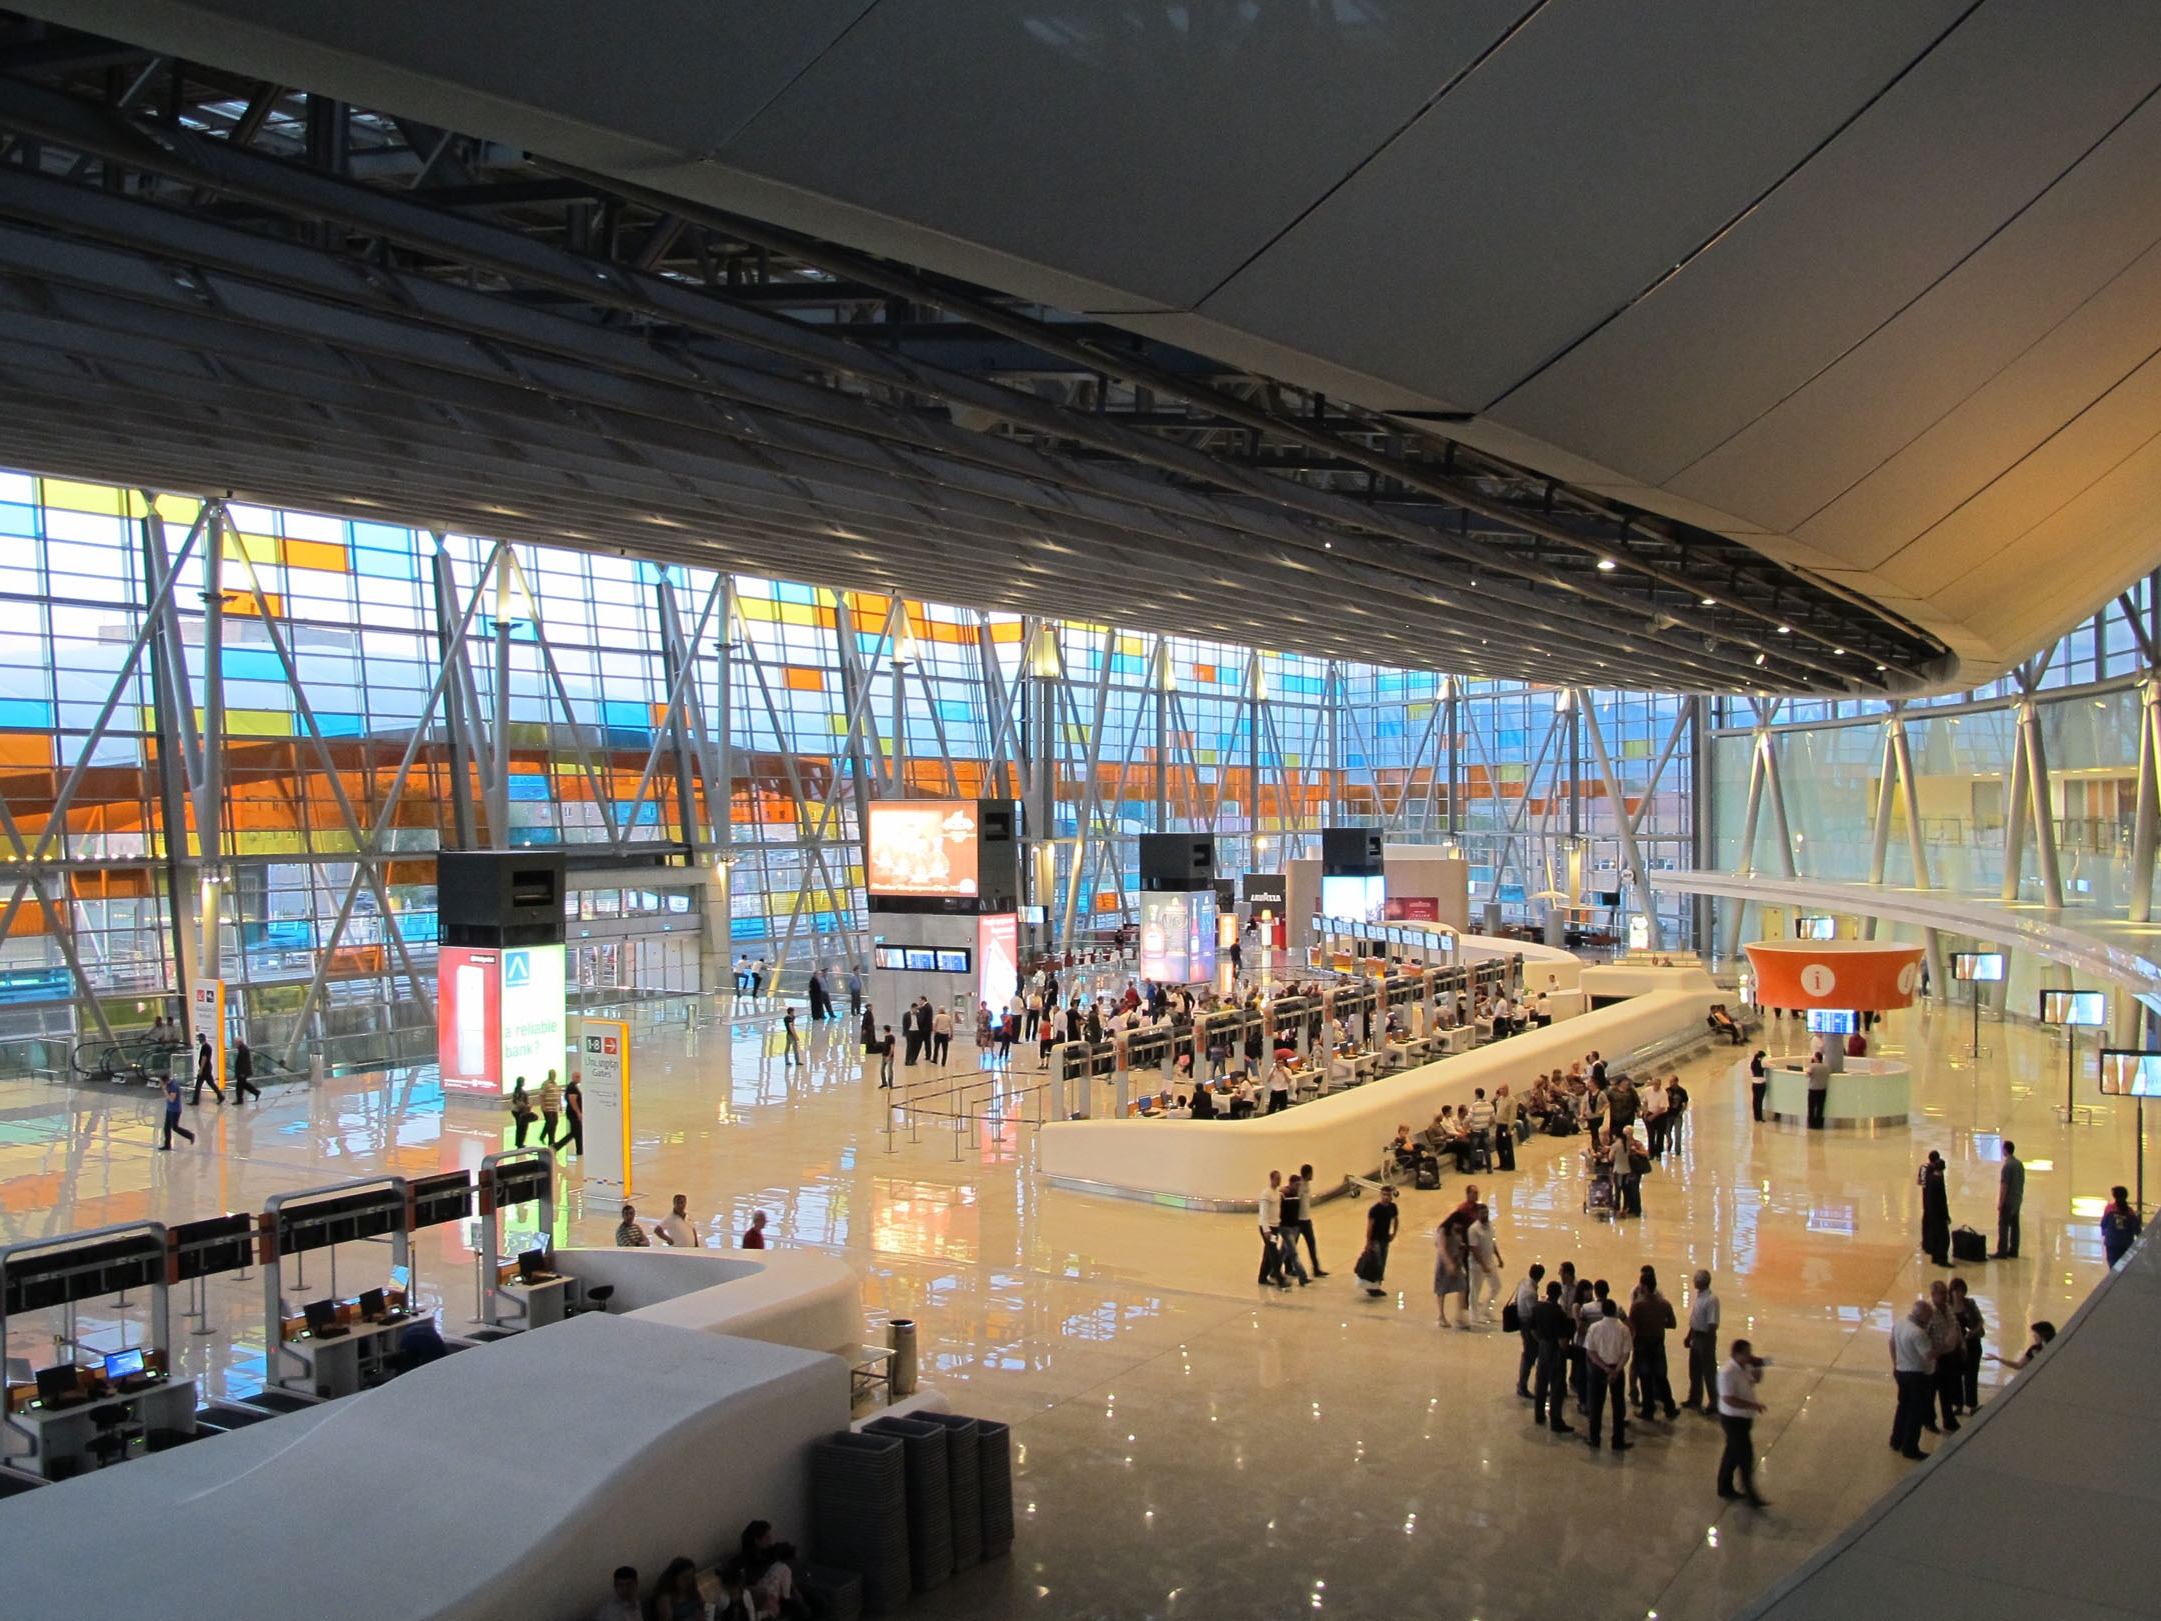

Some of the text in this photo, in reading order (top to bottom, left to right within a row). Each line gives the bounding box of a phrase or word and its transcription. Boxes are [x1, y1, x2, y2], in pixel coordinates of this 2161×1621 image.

[505, 1019, 558, 1038] a reliable
[505, 1040, 540, 1058] bank?
[587, 1039, 601, 1050] 1-8
